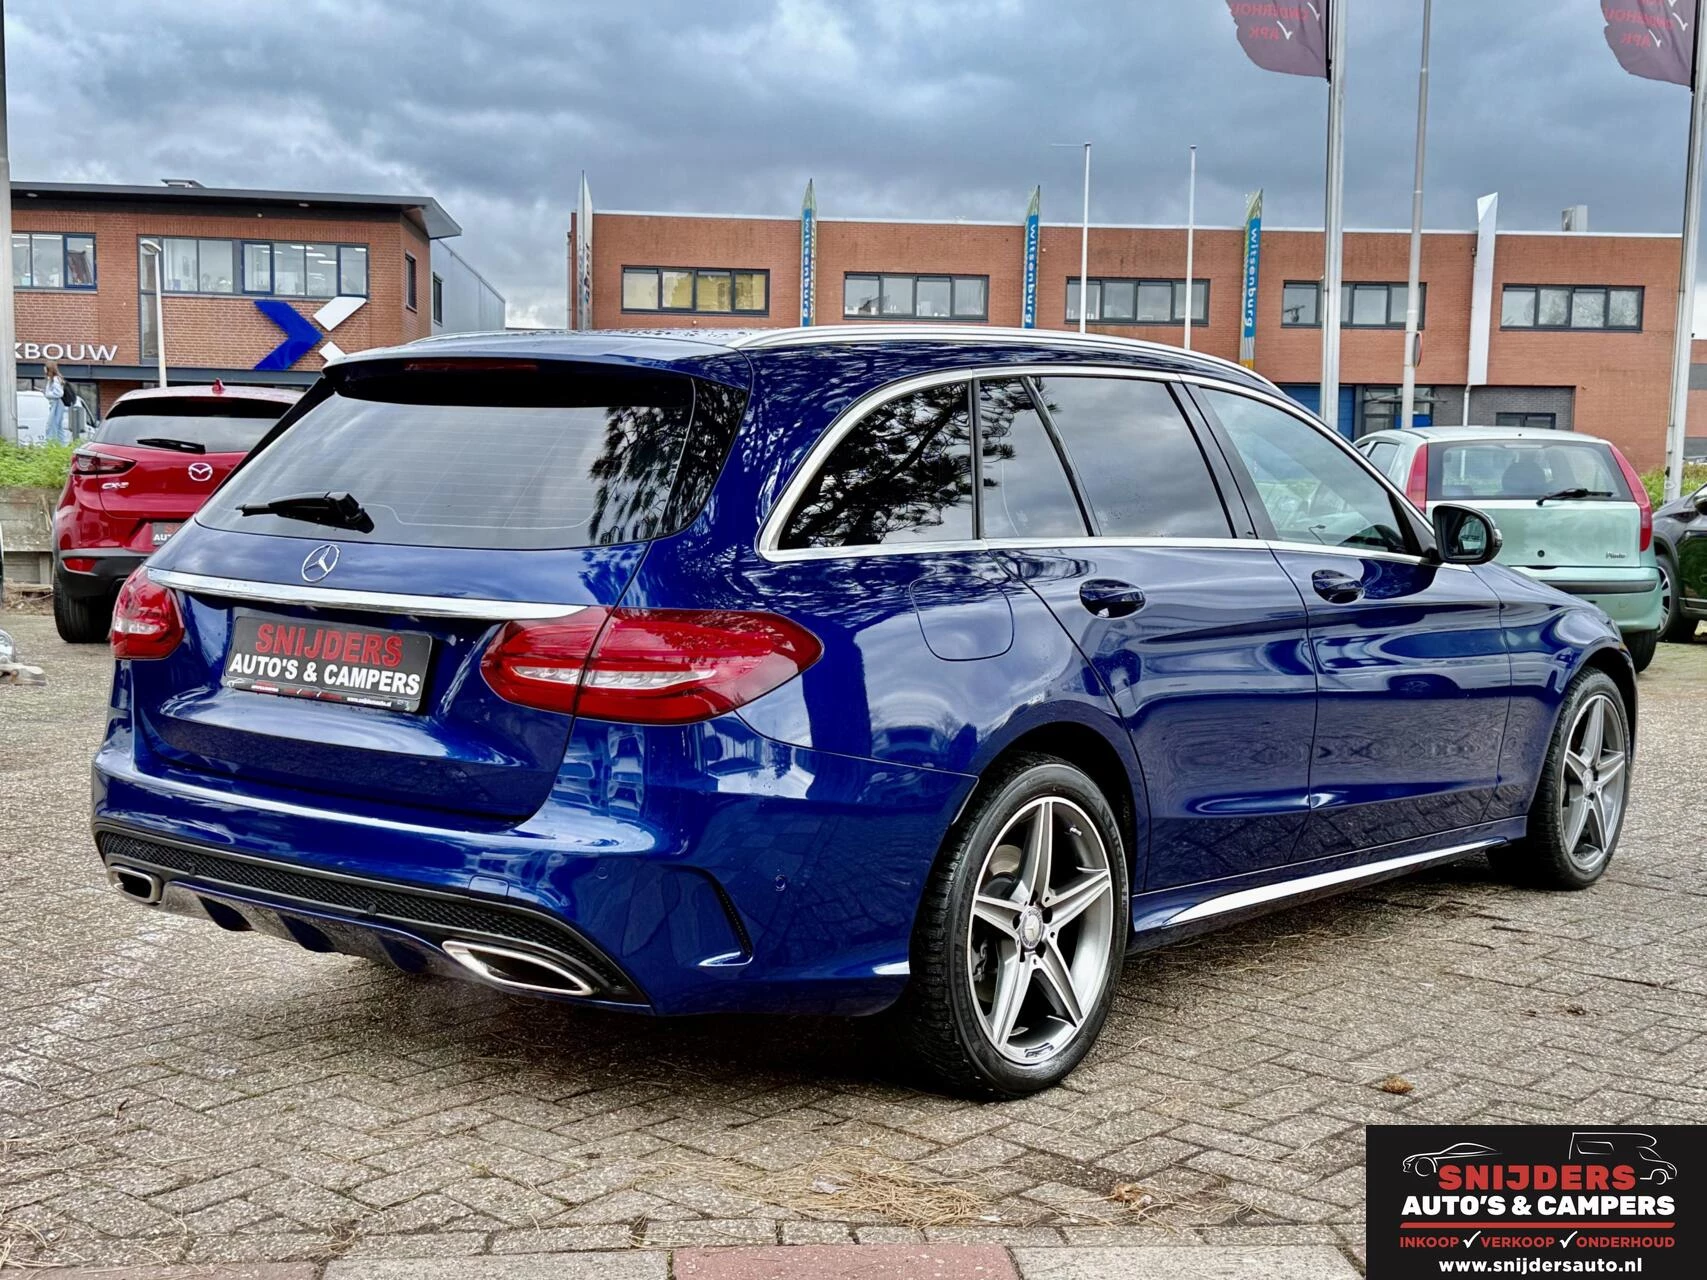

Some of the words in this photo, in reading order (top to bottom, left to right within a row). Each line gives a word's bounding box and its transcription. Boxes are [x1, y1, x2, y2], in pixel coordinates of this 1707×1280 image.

[1025, 223, 1036, 323] witsenburg
[1244, 228, 1258, 328] witsenburg
[228, 653, 298, 680] AUTO'S
[303, 662, 318, 682] &
[323, 664, 420, 695] CAMPERS
[256, 624, 403, 667] SNIJDERS
